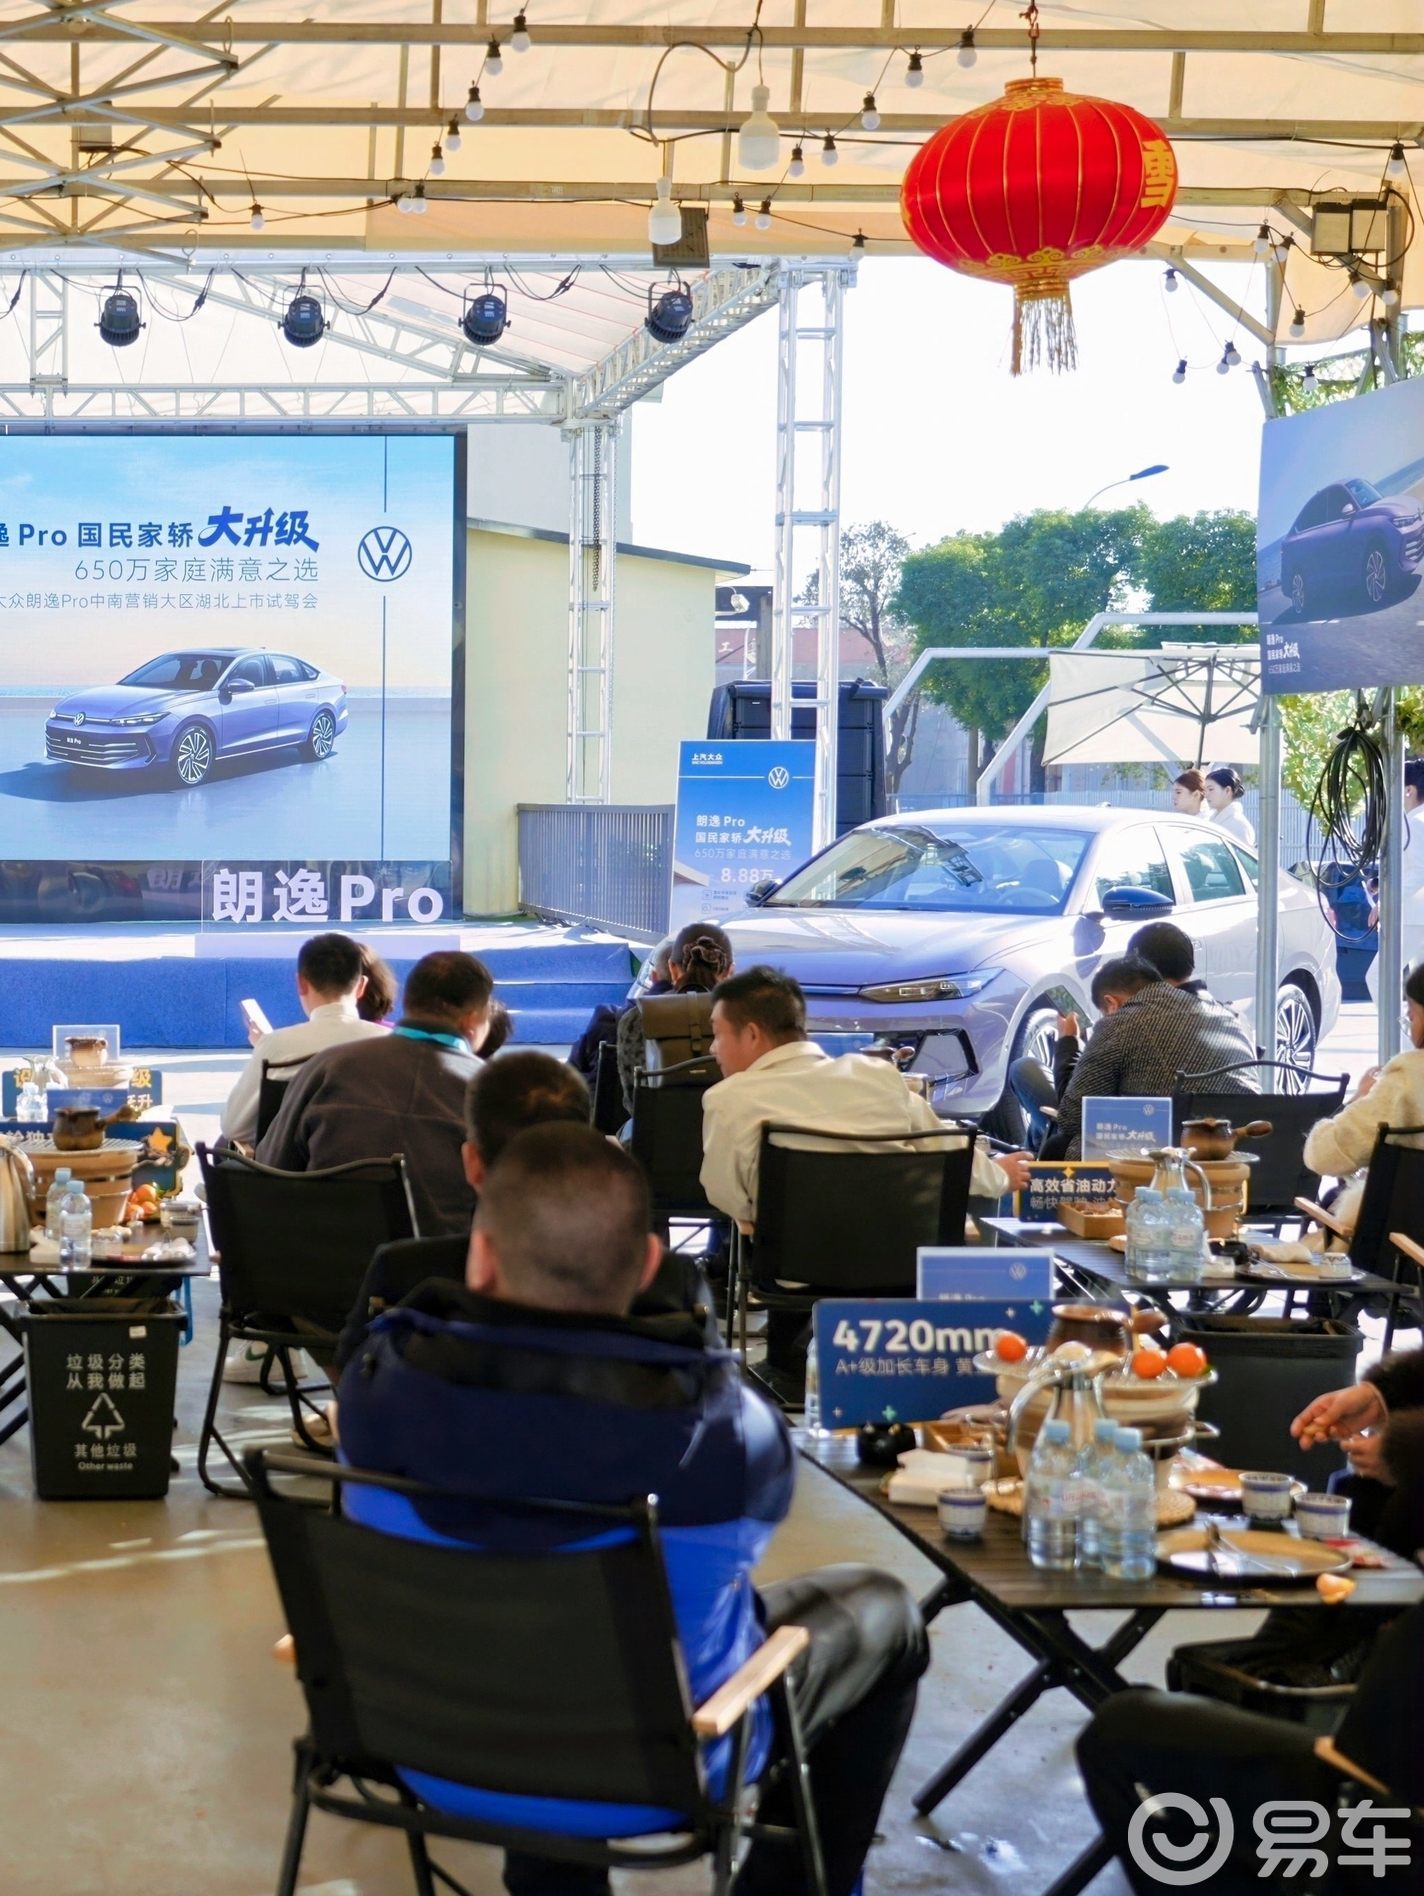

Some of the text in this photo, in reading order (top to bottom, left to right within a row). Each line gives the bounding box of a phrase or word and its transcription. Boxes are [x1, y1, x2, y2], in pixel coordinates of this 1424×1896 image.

[19, 522, 67, 547] Pro
[75, 556, 319, 583] 650万家庭满意之选
[696, 814, 745, 828] 朗逸 Pro
[66, 1352, 146, 1371] 垃圾分类
[836, 1357, 950, 1376] A+级加长车身
[66, 1372, 146, 1390] 从我做起
[74, 1442, 137, 1458] 其他垃圾
[78, 1461, 105, 1471] Other
